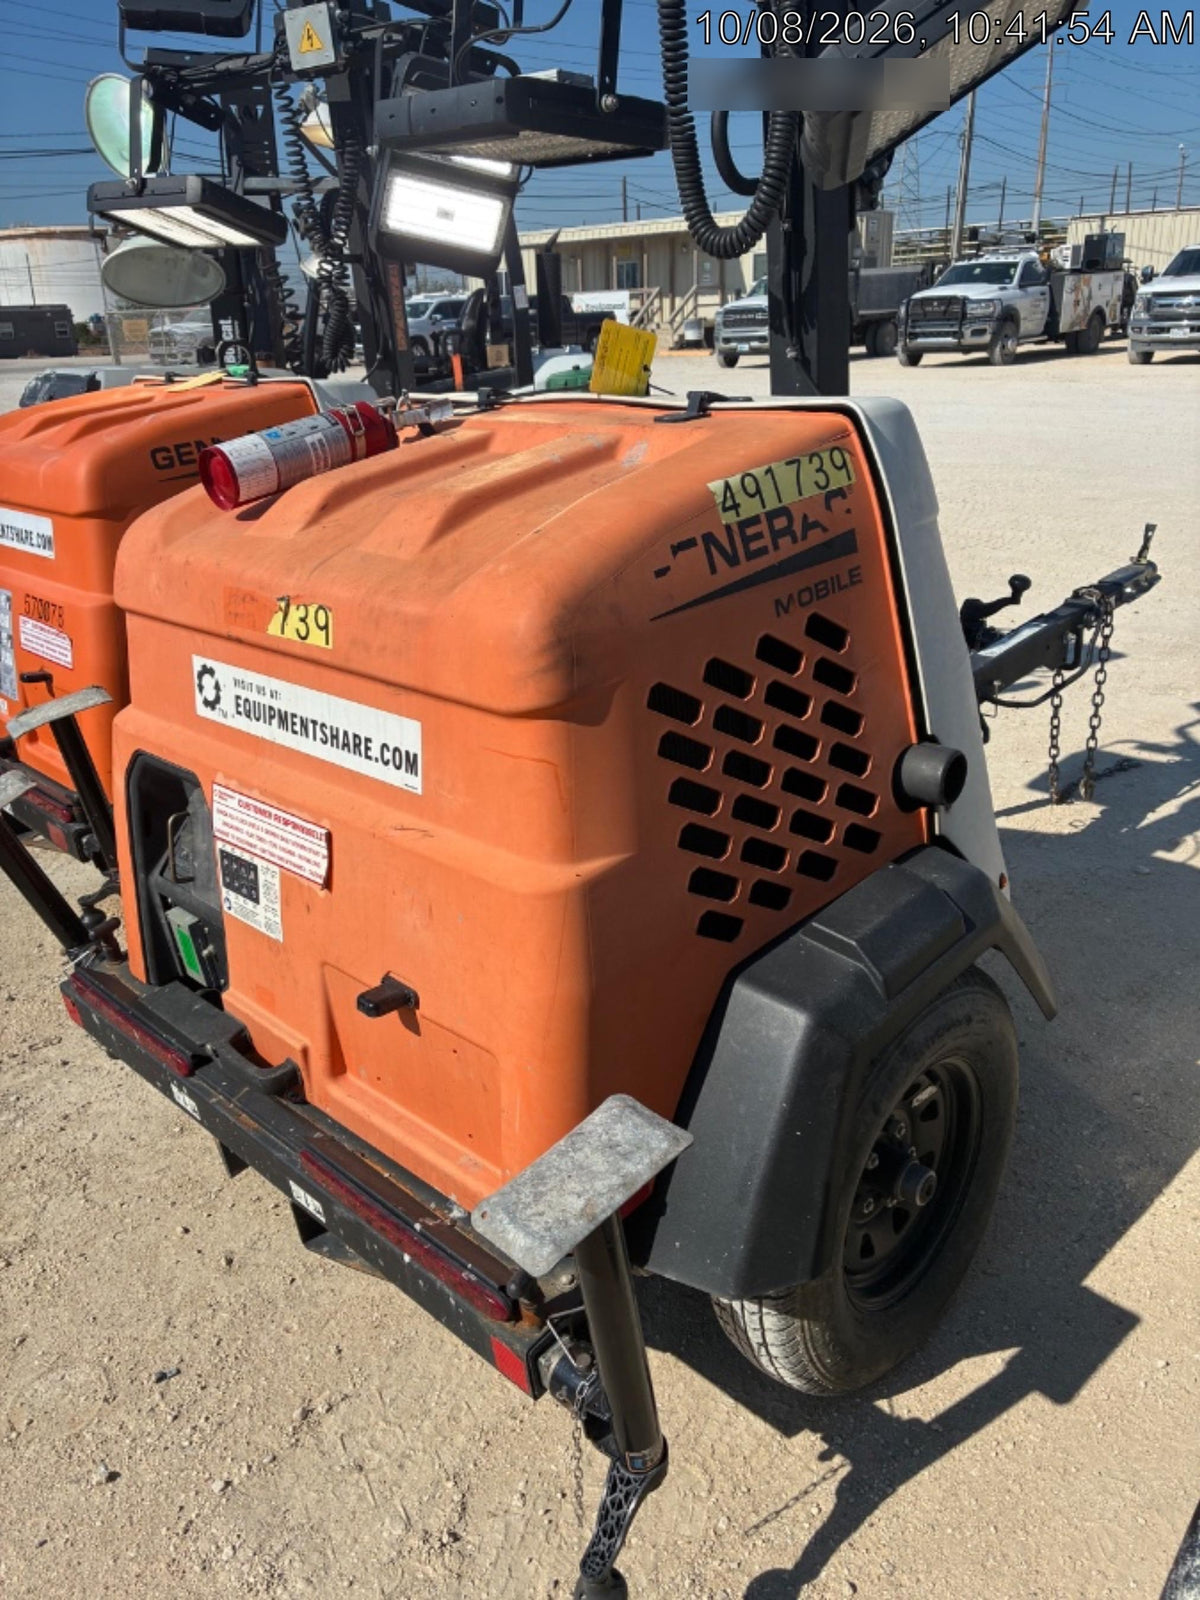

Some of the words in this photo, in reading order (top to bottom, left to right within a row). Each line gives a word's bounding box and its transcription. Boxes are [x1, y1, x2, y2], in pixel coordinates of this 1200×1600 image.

[720, 446, 853, 518] 491739
[774, 565, 863, 617] MOBILE
[276, 595, 330, 646] 739
[232, 677, 253, 693] VISIT
[256, 685, 267, 697] US
[269, 689, 282, 701] AT:
[234, 695, 419, 778] EQUIPMENTSHARE.COM
